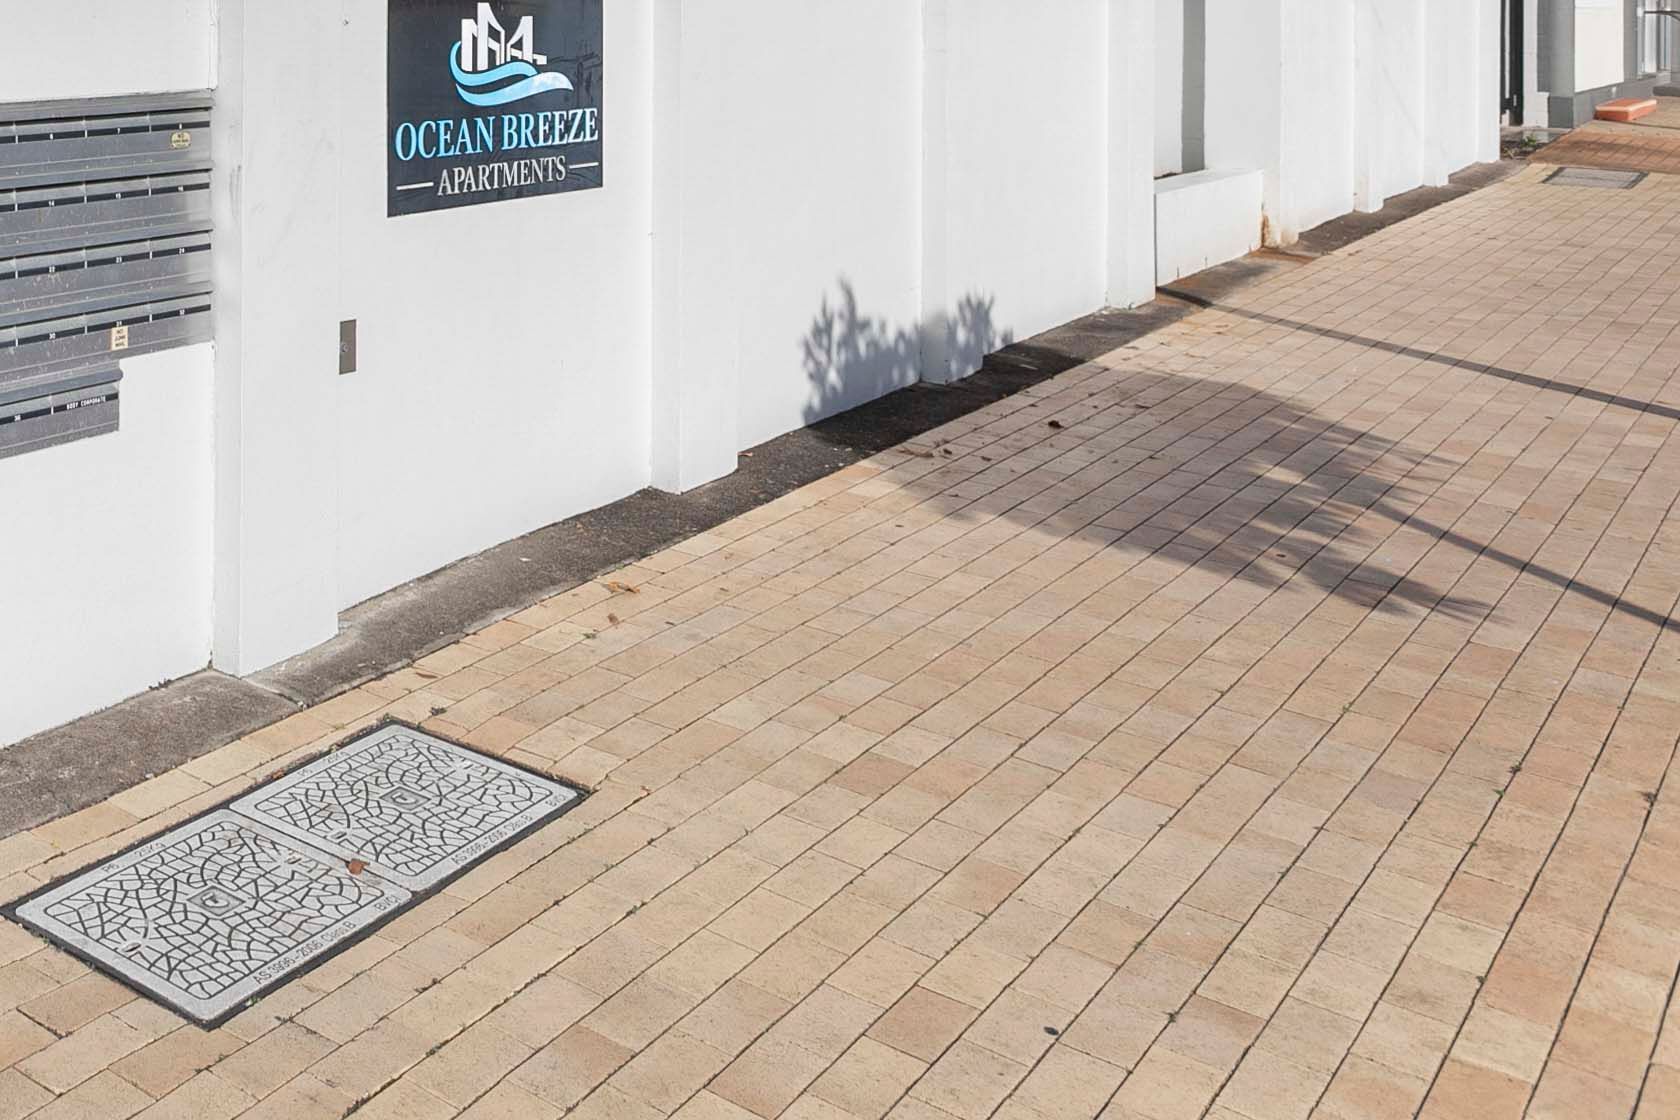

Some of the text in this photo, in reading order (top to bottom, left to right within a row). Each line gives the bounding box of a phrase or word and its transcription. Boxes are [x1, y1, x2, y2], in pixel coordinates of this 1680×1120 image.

[395, 108, 599, 161] OCEAN BREEZE
[437, 155, 566, 196] APARTMENTS
[252, 969, 272, 985] AS
[342, 920, 356, 930] B
